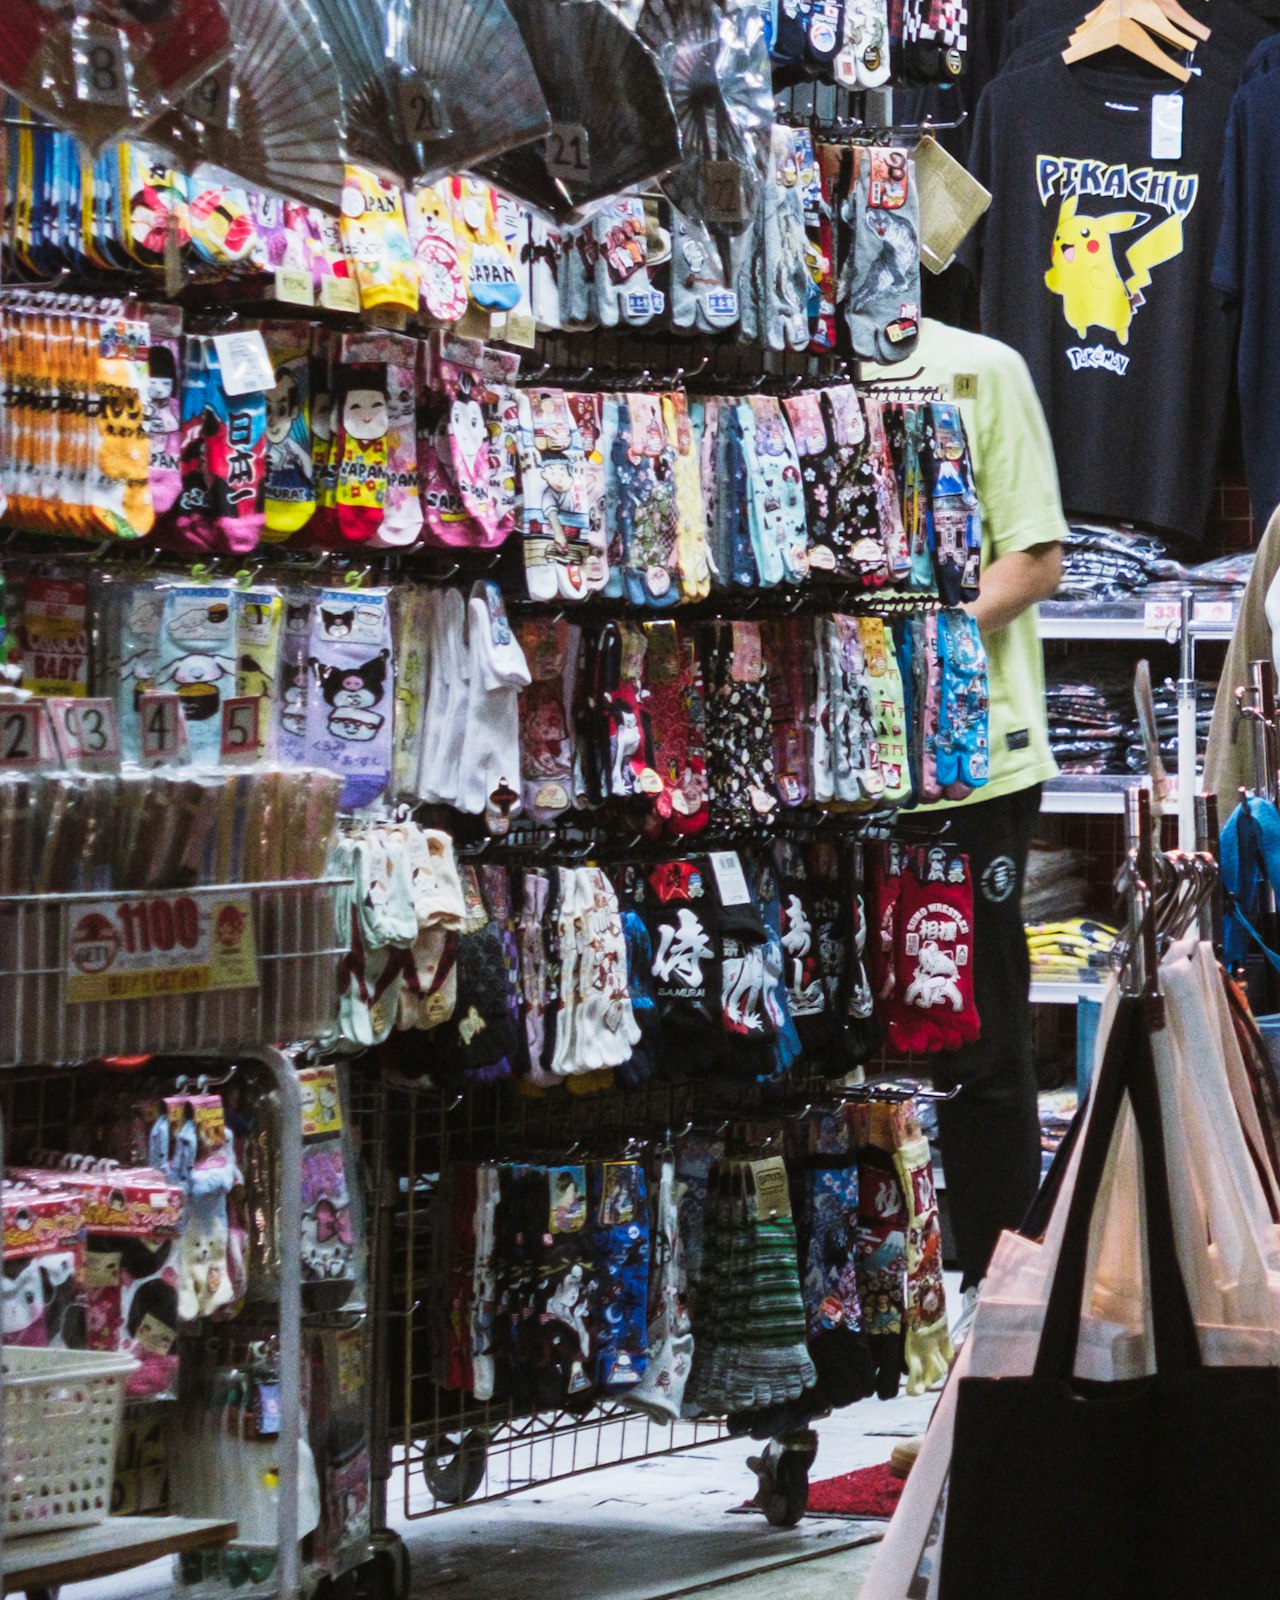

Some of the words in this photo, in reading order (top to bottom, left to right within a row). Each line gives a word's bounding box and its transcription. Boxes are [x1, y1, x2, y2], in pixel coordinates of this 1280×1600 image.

[552, 135, 589, 172] 21
[1036, 155, 1199, 219] PIKACHU
[469, 265, 517, 283] JAPAN
[226, 412, 257, 504] 日本一
[3, 713, 28, 759] 2
[82, 708, 107, 751] 3
[147, 706, 171, 751] 4
[228, 706, 249, 749] 5
[116, 896, 199, 953] 1100
[651, 908, 715, 988] 侍
[658, 987, 706, 998] SAMURAI
